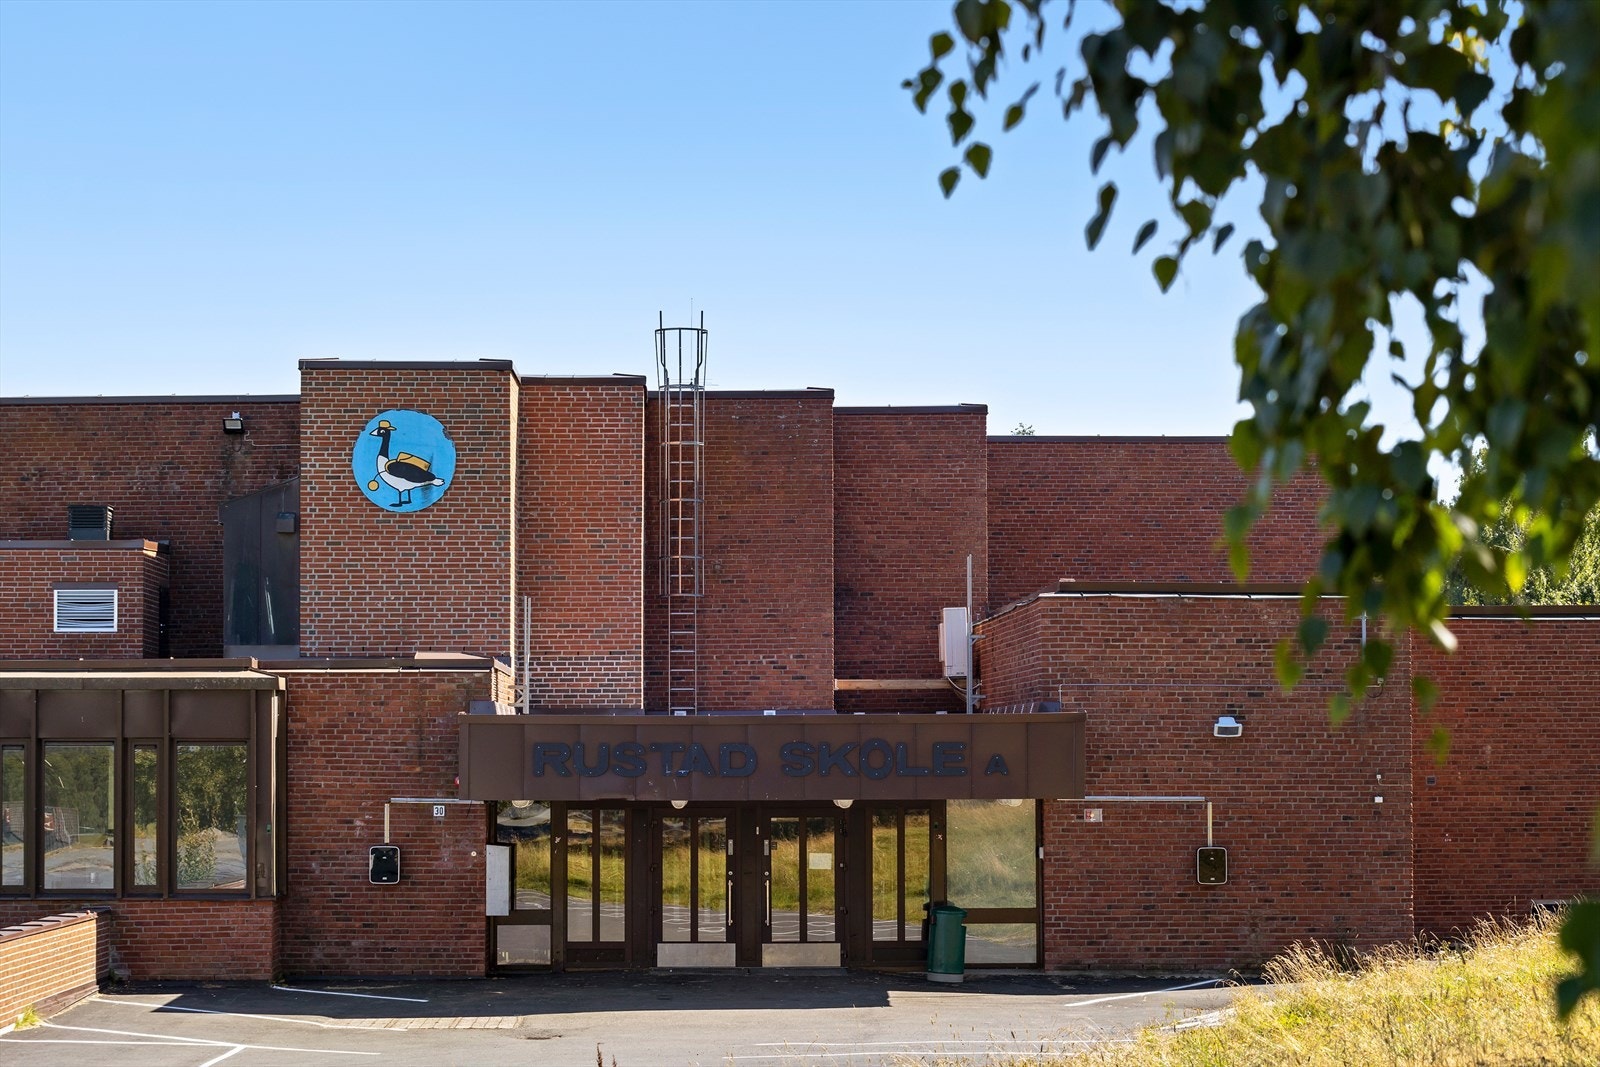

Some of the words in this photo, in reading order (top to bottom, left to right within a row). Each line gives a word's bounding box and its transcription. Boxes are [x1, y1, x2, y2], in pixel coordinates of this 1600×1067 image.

[533, 742, 758, 777] RUSTAD
[780, 738, 968, 780] SKOLE
[985, 753, 1009, 776] A
[434, 806, 444, 816] 30
